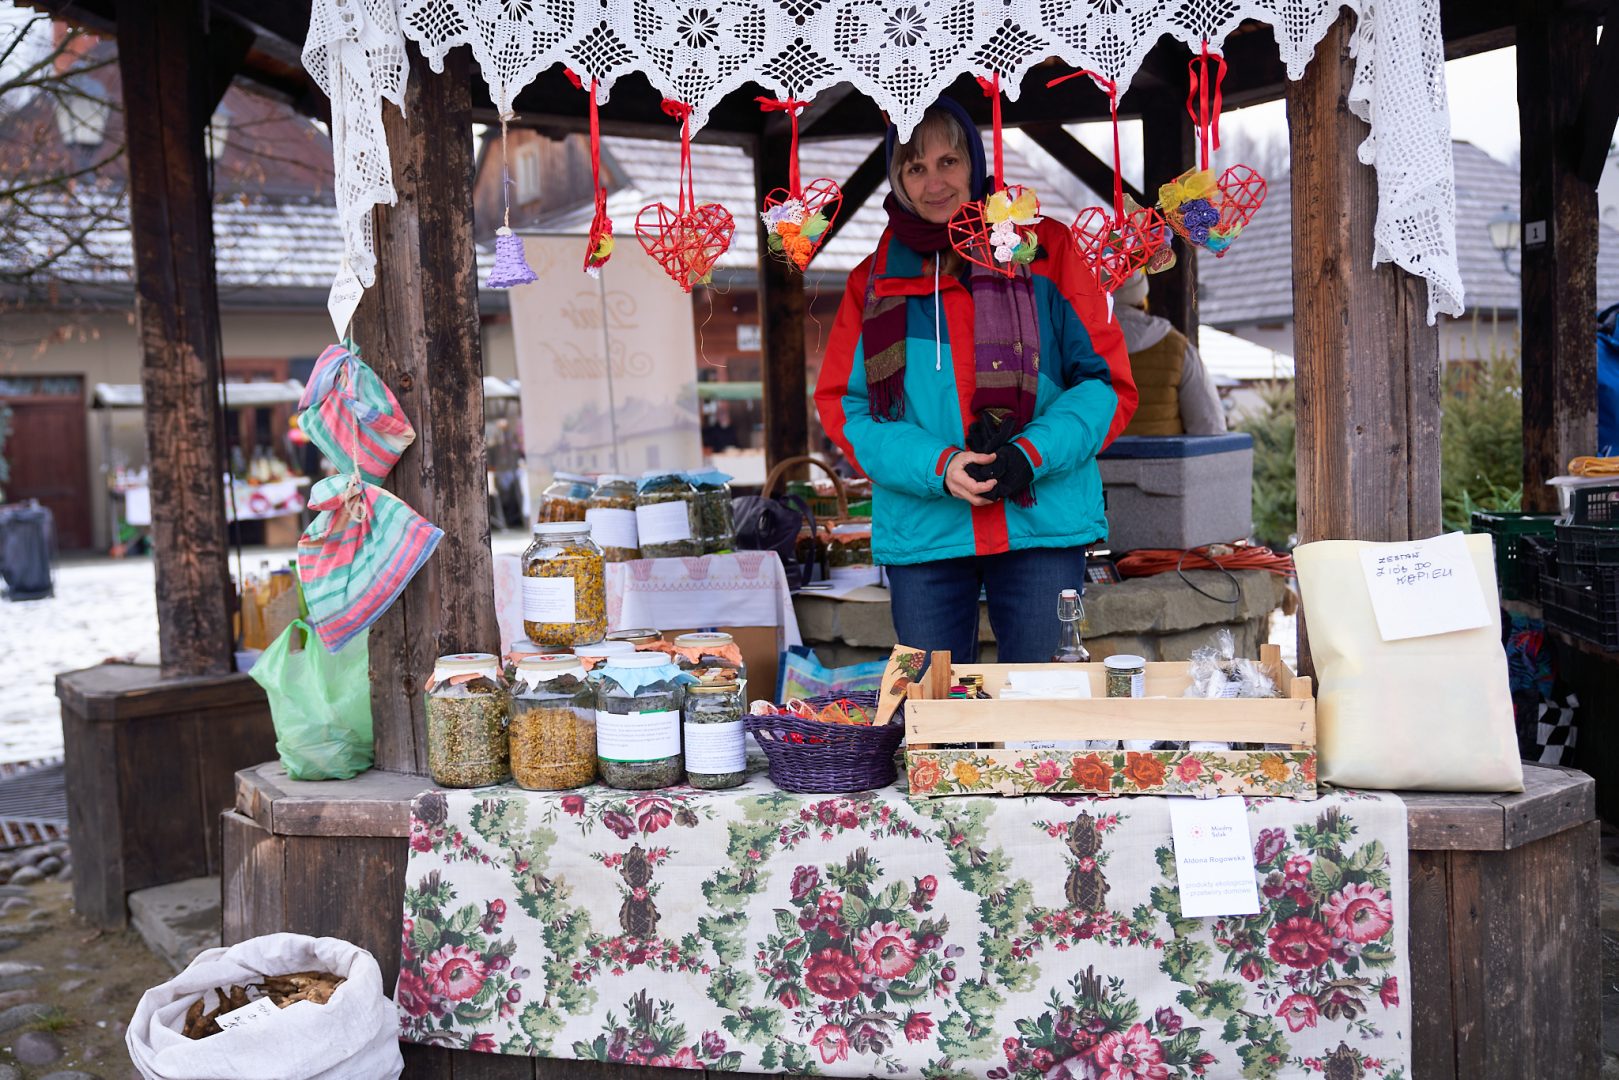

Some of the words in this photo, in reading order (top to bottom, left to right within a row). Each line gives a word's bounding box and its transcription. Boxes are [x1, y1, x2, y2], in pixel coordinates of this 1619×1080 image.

[1533, 227, 1539, 240] 1
[1378, 552, 1420, 564] ZESTAW
[1414, 561, 1432, 571] DO
[1209, 856, 1246, 864] Rogowska
